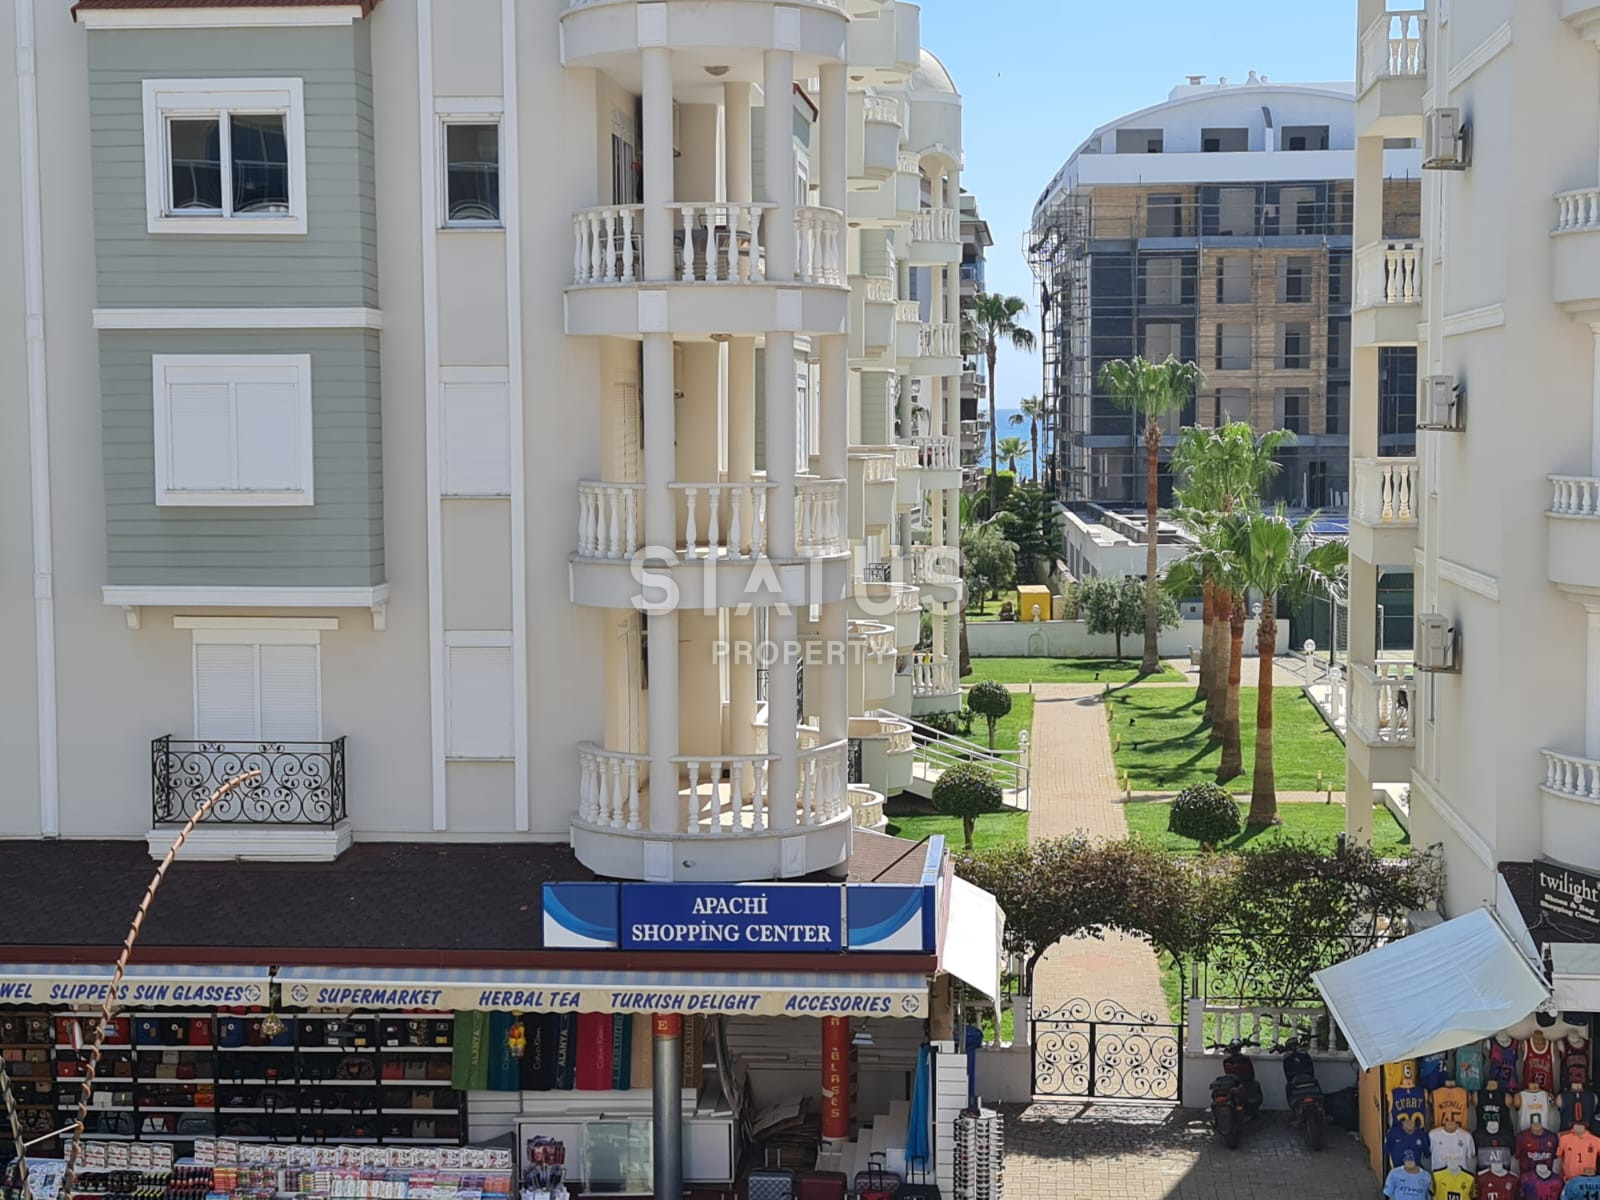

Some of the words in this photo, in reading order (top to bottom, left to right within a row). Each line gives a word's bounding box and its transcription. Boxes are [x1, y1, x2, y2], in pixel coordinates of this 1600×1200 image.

[1540, 872, 1598, 903] twilight
[745, 924, 832, 942] CENTER
[50, 984, 129, 1000] SLIPPES
[134, 985, 169, 1000] SUN
[172, 985, 244, 1001] GLASSES
[317, 988, 442, 1006] SUPERMARKET
[479, 991, 543, 1007] HERBAL
[551, 991, 581, 1007] TEA
[610, 992, 684, 1009] TURKISH
[688, 993, 761, 1011] DELIGHT
[785, 995, 892, 1012] ACCESORIES
[471, 1030, 480, 1065] ALANYA
[558, 1029, 568, 1066] ALANYA
